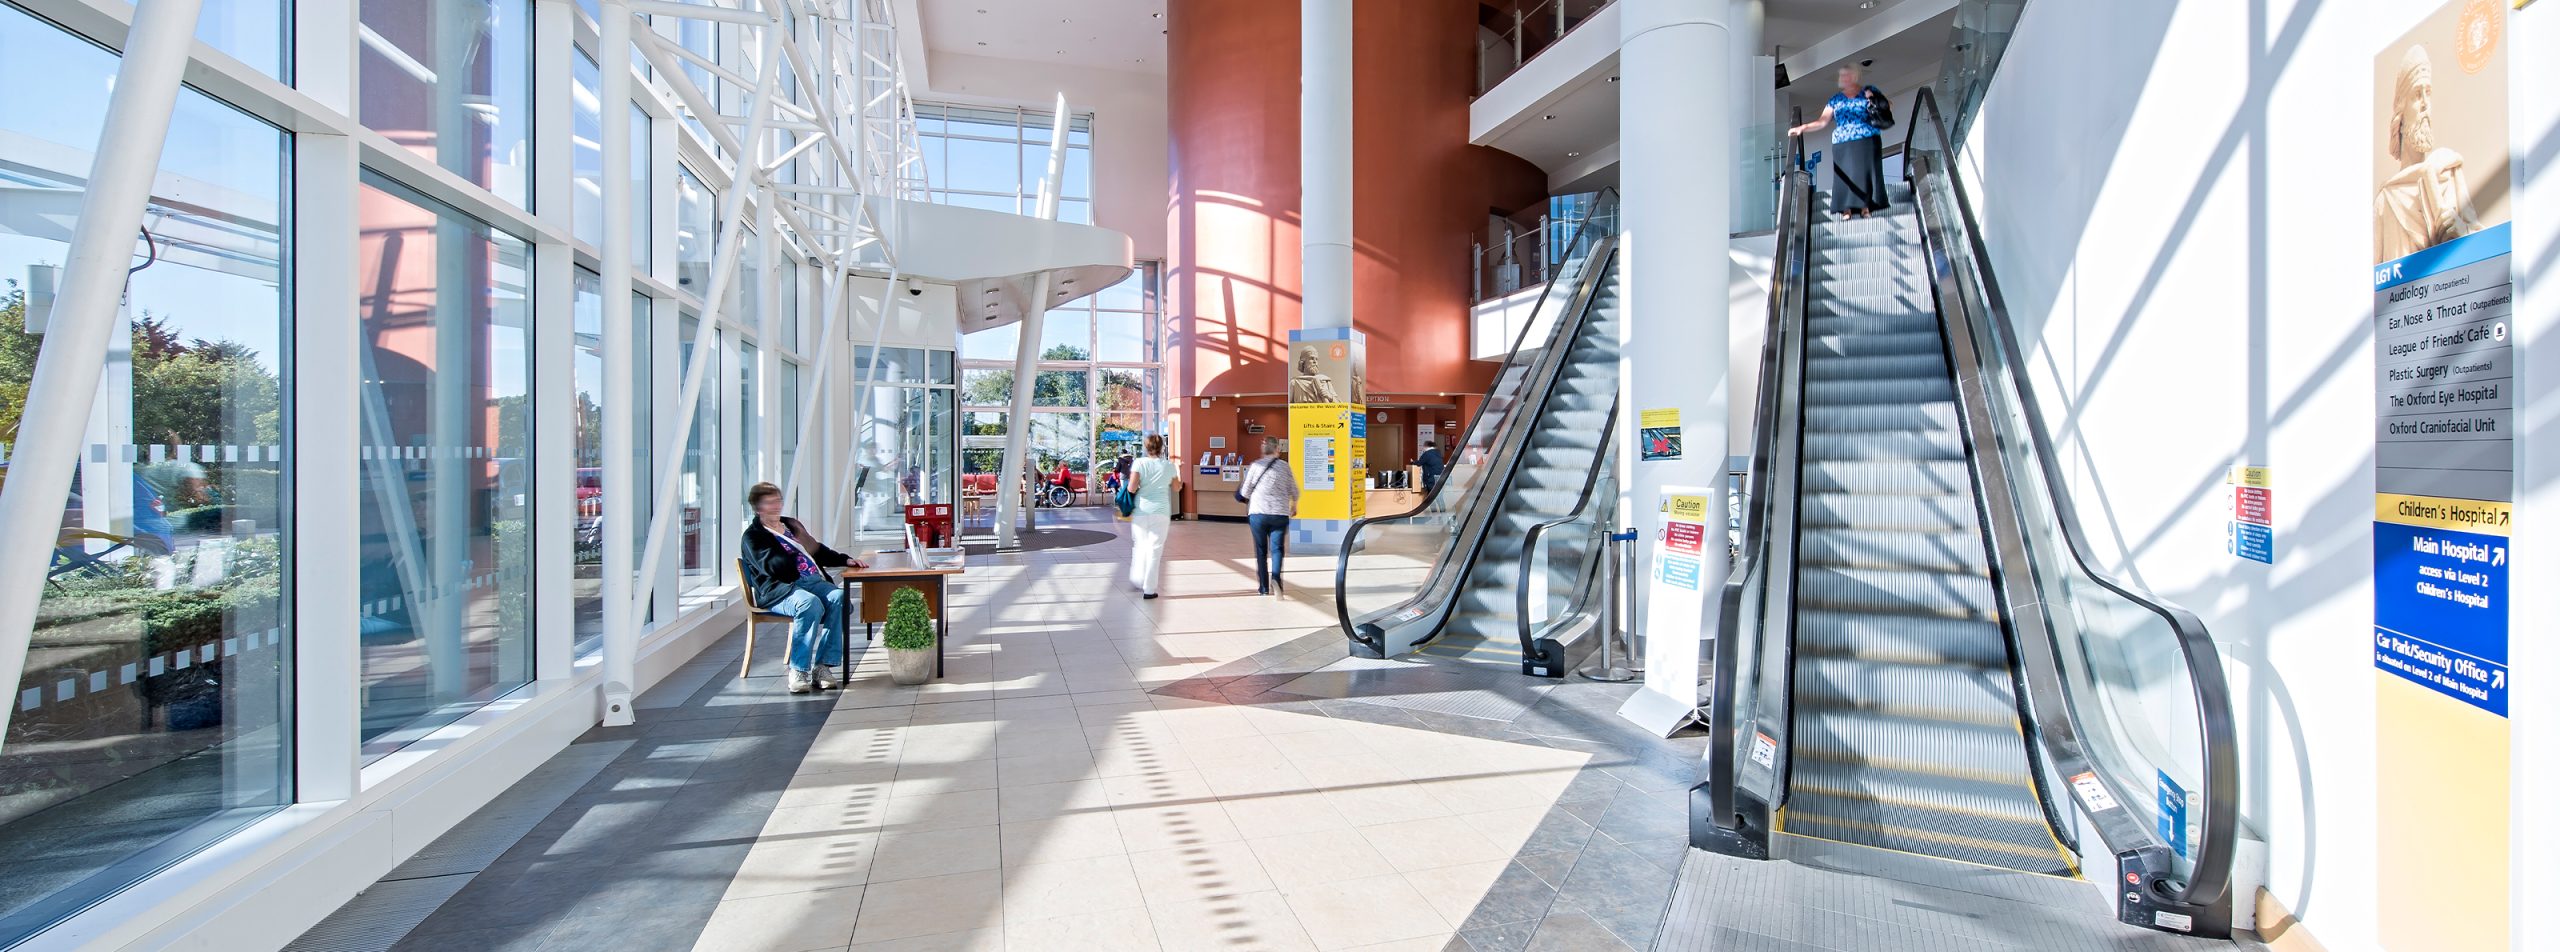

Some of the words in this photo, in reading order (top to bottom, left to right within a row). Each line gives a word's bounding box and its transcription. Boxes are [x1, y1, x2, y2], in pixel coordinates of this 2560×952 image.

[2376, 267, 2390, 284] LG1
[2389, 284, 2429, 303] Audiology
[2433, 275, 2470, 292] (Outpatients)
[2404, 313, 2423, 327] Nose
[2427, 309, 2433, 321] &
[2437, 303, 2467, 319] Throat
[2470, 294, 2511, 311] (Outpatients)
[2389, 341, 2417, 356] League
[2420, 337, 2429, 350] of
[2467, 325, 2490, 342] Café
[2389, 366, 2413, 381] Plastic
[2416, 363, 2448, 380] Surgery
[2453, 361, 2493, 375] (Outpatients)
[2390, 395, 2404, 407] The
[2407, 391, 2436, 406] Oxford
[2439, 391, 2455, 407] Eye
[2458, 385, 2498, 402] Hospital
[2389, 422, 2417, 435] Oxford
[2420, 418, 2471, 433] Craniofacial
[2475, 418, 2495, 432] Unit
[1676, 499, 1700, 509] Caution
[2398, 501, 2446, 520] Children's
[2450, 506, 2497, 527] Hospital
[2413, 536, 2438, 555] Main
[2441, 540, 2488, 563] Hospital
[2419, 565, 2442, 579] access
[2444, 568, 2456, 581] via
[2458, 570, 2480, 586] Level
[2482, 575, 2488, 588] 2
[2416, 581, 2452, 601] Children's
[2454, 590, 2488, 609] Hospital
[2376, 632, 2391, 649] Car
[2392, 637, 2452, 673] Park/Security
[2455, 658, 2488, 683] Office
[2382, 654, 2403, 670] situated
[2403, 662, 2412, 672] on
[2412, 664, 2427, 678] Level
[2433, 673, 2441, 684] of
[2442, 676, 2458, 690] Main
[2460, 682, 2488, 700] Hospital
